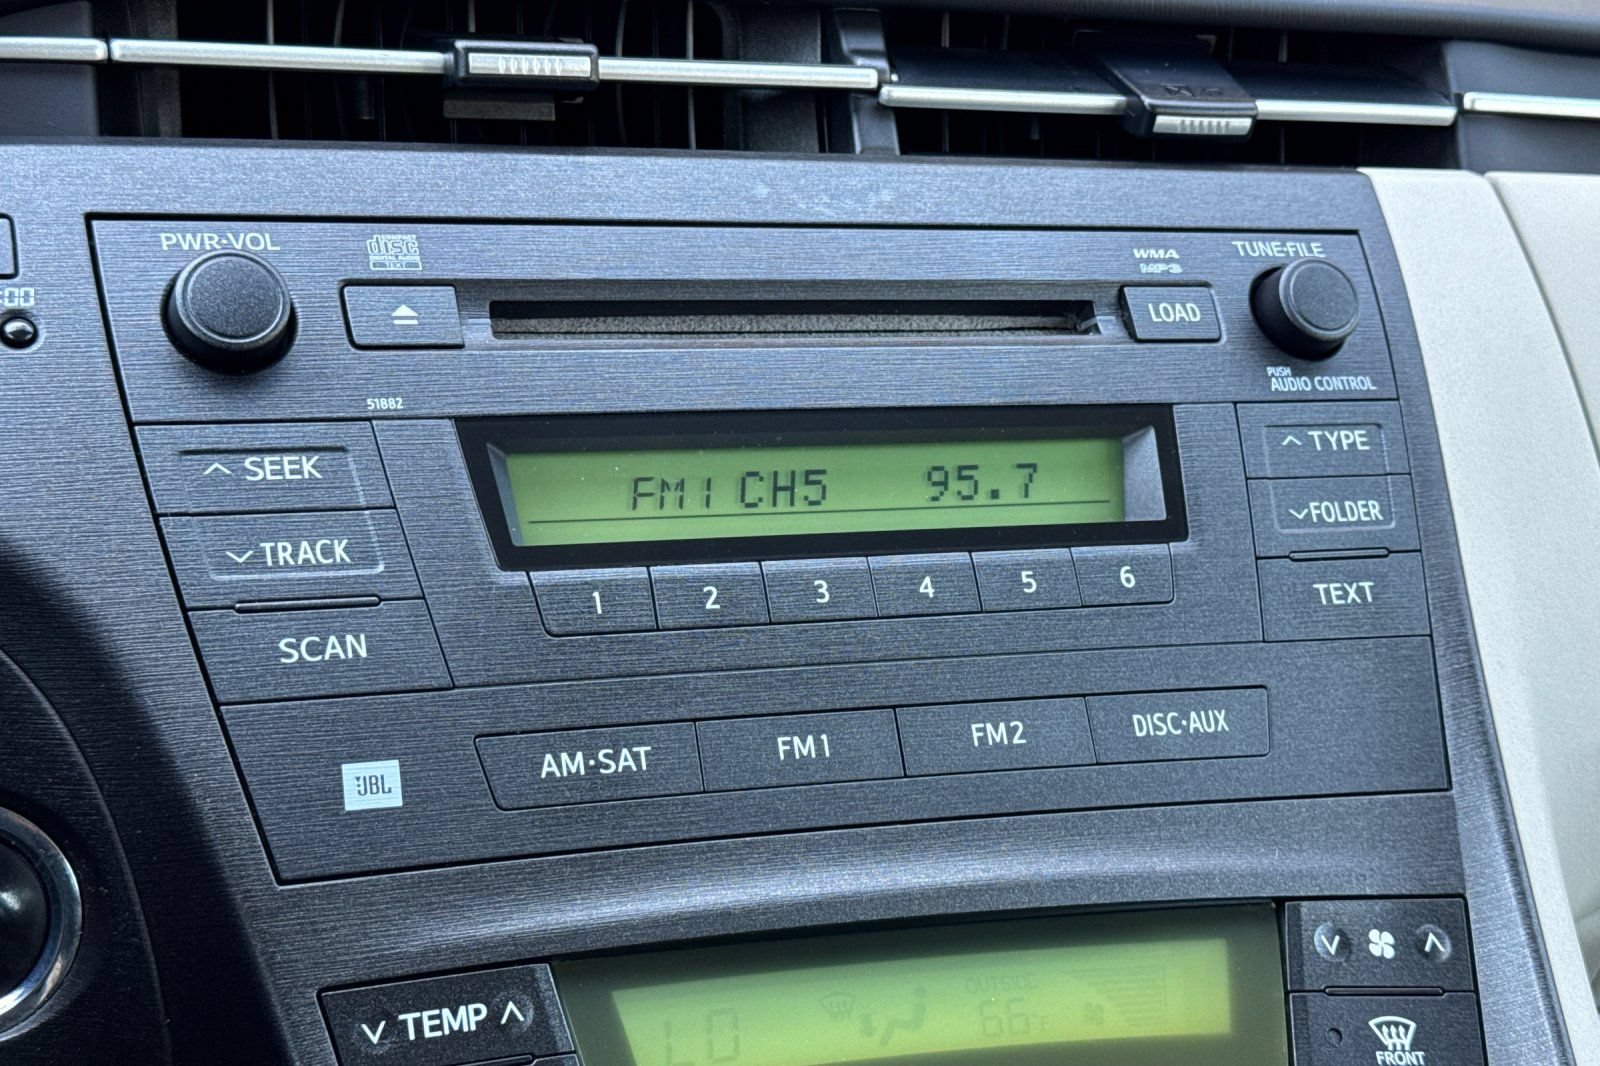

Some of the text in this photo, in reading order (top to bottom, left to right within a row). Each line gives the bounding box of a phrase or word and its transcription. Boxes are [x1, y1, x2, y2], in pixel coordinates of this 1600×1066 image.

[1132, 248, 1180, 259] WMA
[1148, 302, 1201, 322] LOAD
[1267, 366, 1292, 377] PUSH
[1271, 376, 1378, 391] AUDIO CONTROL
[366, 397, 404, 410] 51882
[1307, 430, 1370, 451] TYPE
[244, 455, 322, 481] SEEK
[632, 462, 1038, 511] FM1 CH5 95.7
[1309, 499, 1384, 523] FOLDER
[260, 539, 351, 566] TRACK
[919, 576, 935, 598] 4
[1021, 570, 1037, 593] 5
[1119, 565, 1136, 588] 6
[592, 591, 602, 614] 1
[703, 586, 721, 610] 2
[813, 580, 830, 603] 3
[1312, 581, 1375, 605] TEXT
[278, 633, 368, 663] SCAN
[971, 720, 1027, 747] FM2
[776, 733, 831, 760] FM1
[355, 773, 393, 797] JBL
[965, 972, 1039, 995] OUTSIDE
[398, 1002, 488, 1041] TEMP
[1375, 1050, 1427, 1066] FRONT
